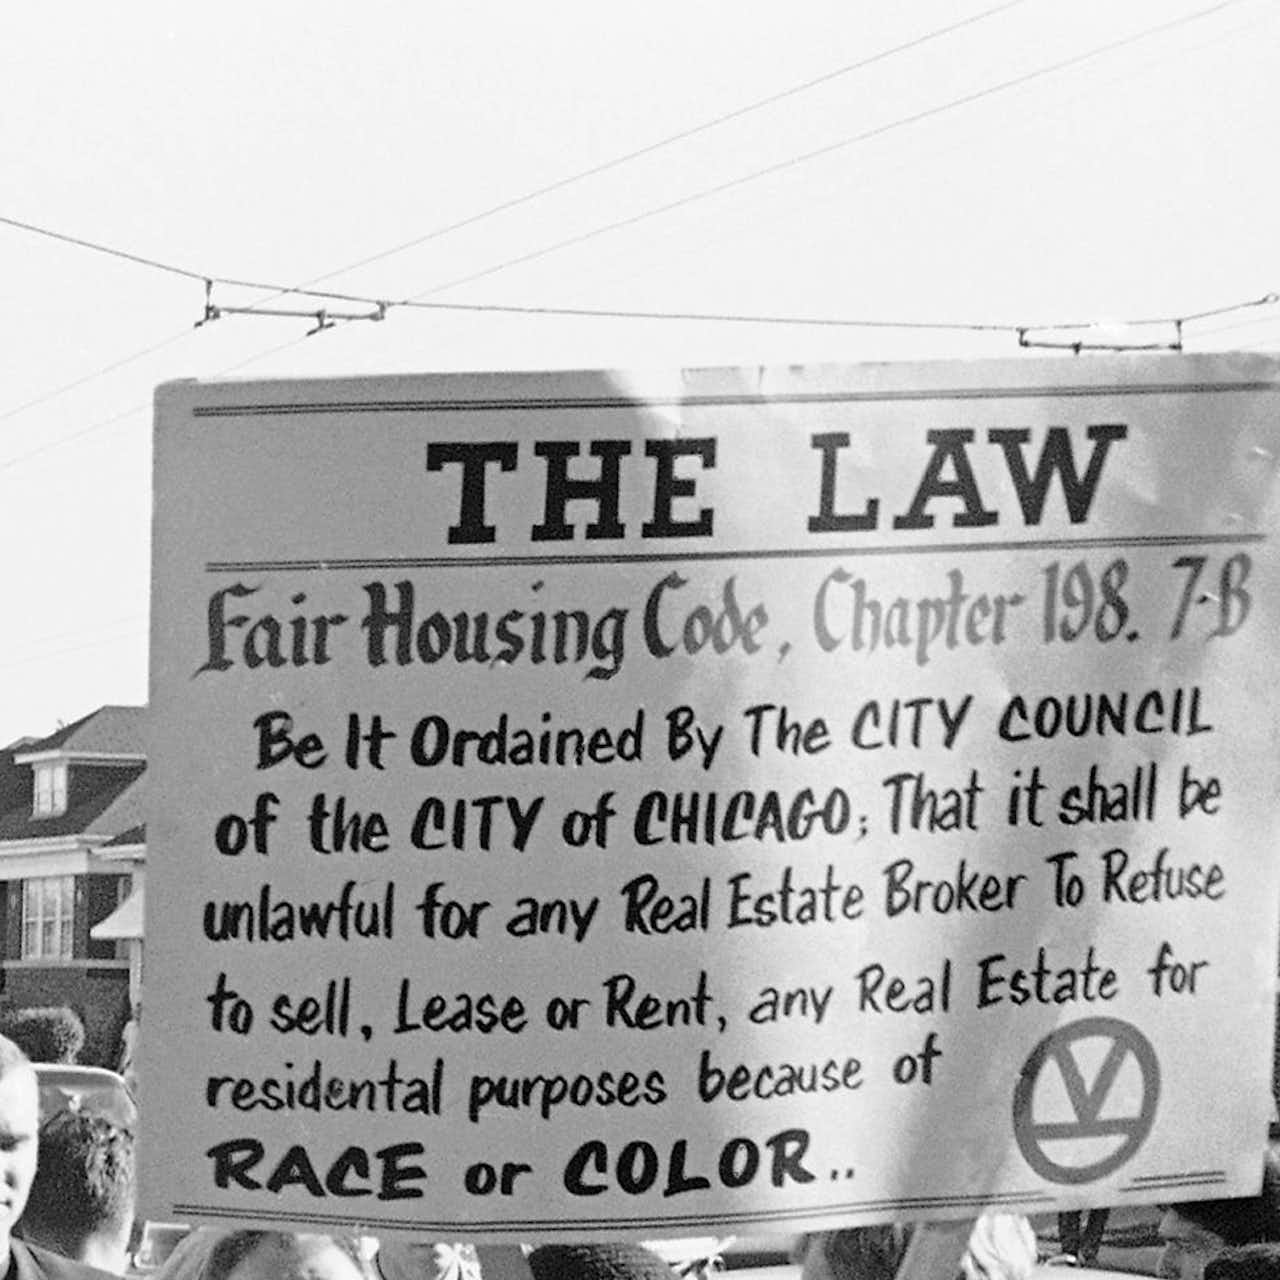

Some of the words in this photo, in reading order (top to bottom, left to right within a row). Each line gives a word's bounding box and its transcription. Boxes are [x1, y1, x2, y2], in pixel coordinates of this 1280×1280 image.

[427, 438, 716, 544] THE
[808, 424, 1127, 532] LAW
[194, 583, 348, 677] Fair
[361, 580, 629, 680] Housing
[816, 569, 1023, 664] Chapter
[1045, 559, 1140, 642] 198.
[254, 711, 328, 769] Be
[346, 713, 397, 770] It
[411, 709, 644, 767] Ordained
[666, 706, 724, 771] By
[744, 705, 831, 756] The
[852, 695, 973, 749] CITY
[999, 687, 1213, 742] COUNCIL
[215, 792, 279, 855] of
[307, 794, 389, 854] the
[411, 796, 545, 852] CITY
[563, 791, 617, 849] of
[883, 770, 983, 834] That
[1008, 767, 1047, 826] it
[1058, 761, 1156, 825] shall
[1180, 766, 1221, 819] be
[204, 881, 394, 943] unlawful
[415, 882, 492, 939] for
[507, 897, 599, 942] any
[621, 874, 710, 934] Real
[728, 865, 863, 928] Estate
[884, 859, 1028, 917] Broker
[1045, 851, 1084, 907] To
[1101, 848, 1224, 903] Refuse
[206, 973, 253, 1035] to
[270, 977, 372, 1042] sell,
[394, 979, 528, 1033] Lease
[547, 998, 591, 1030] or
[603, 971, 726, 1033] Rent,
[749, 987, 832, 1023] any
[856, 959, 951, 1013] Real
[977, 947, 1117, 1009] Estate
[1148, 942, 1208, 997] for
[469, 1071, 667, 1123] purposes
[698, 1050, 862, 1102] because
[894, 1033, 942, 1085] of
[206, 1139, 427, 1201] RACE
[465, 1163, 533, 1195] or
